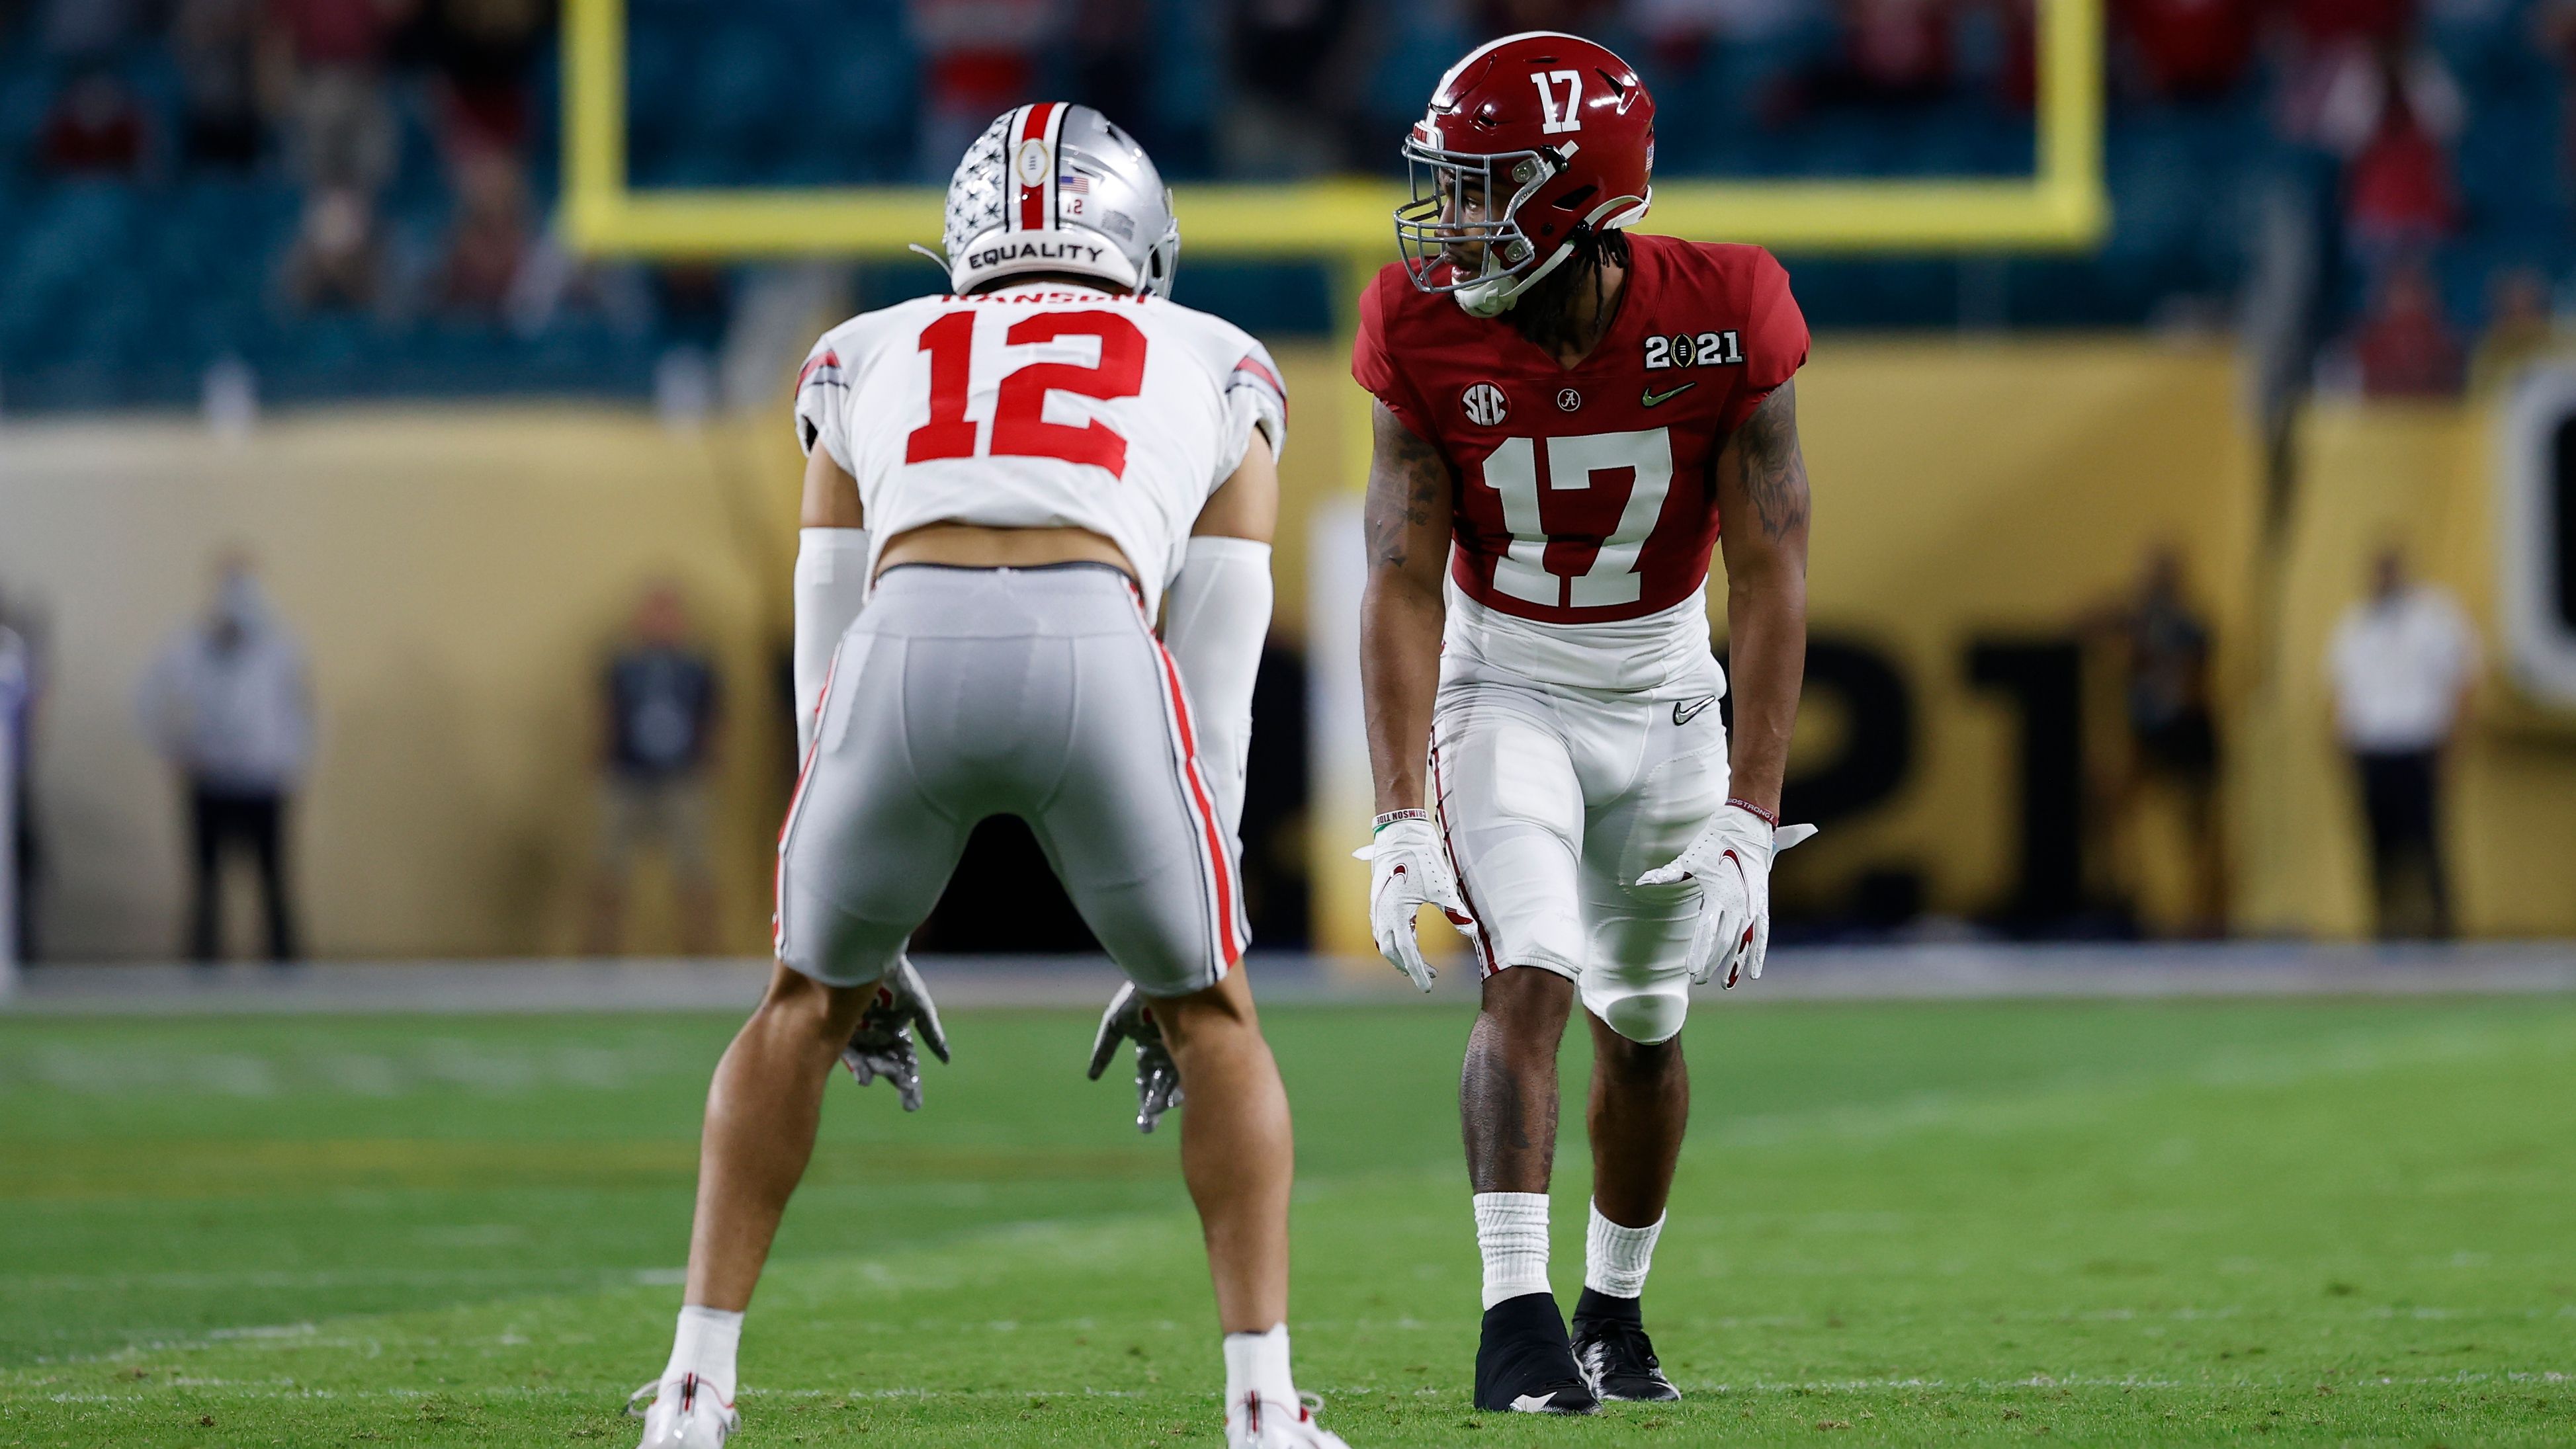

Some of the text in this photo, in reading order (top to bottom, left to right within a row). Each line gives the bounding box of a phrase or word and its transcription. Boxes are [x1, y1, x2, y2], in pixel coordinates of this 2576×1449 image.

[1530, 69, 1582, 134] 17
[968, 242, 1103, 270] EQUALITY
[1645, 330, 1744, 369] 2021
[906, 310, 1148, 482] 12
[1461, 384, 1506, 427] SEC
[1482, 427, 1673, 607] 17
[1377, 810, 1426, 825] CRIMSON TIDE
